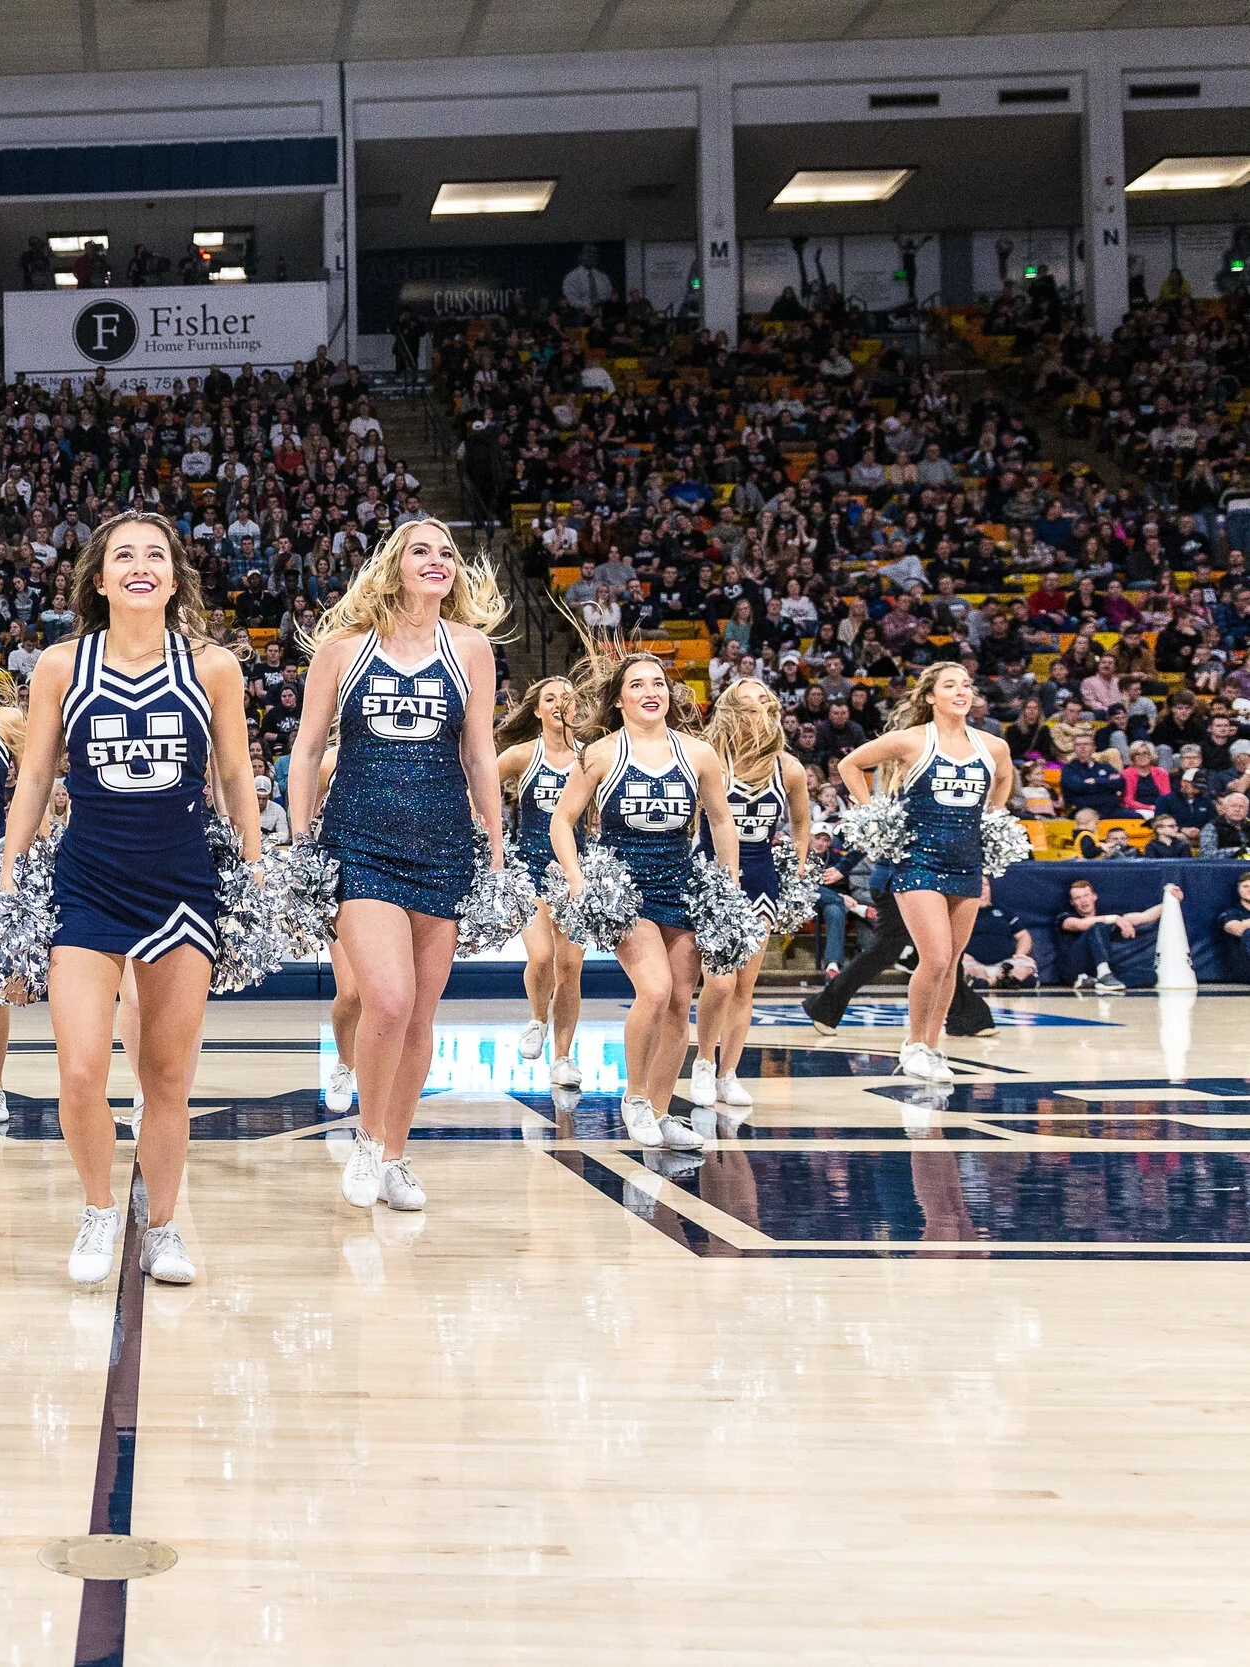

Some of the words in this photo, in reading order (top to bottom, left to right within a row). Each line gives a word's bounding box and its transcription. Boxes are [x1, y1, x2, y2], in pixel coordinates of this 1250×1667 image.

[1103, 229, 1120, 247] N
[710, 240, 729, 259] M
[149, 303, 255, 337] Fisher
[92, 314, 120, 350] F
[144, 339, 184, 353] Home
[187, 337, 262, 352] Furnishings
[362, 694, 448, 721] STATE
[87, 737, 188, 767] STATE
[533, 786, 564, 800] STA
[930, 775, 987, 794] STATE
[619, 797, 691, 817] STATE
[733, 815, 777, 829] TATE
